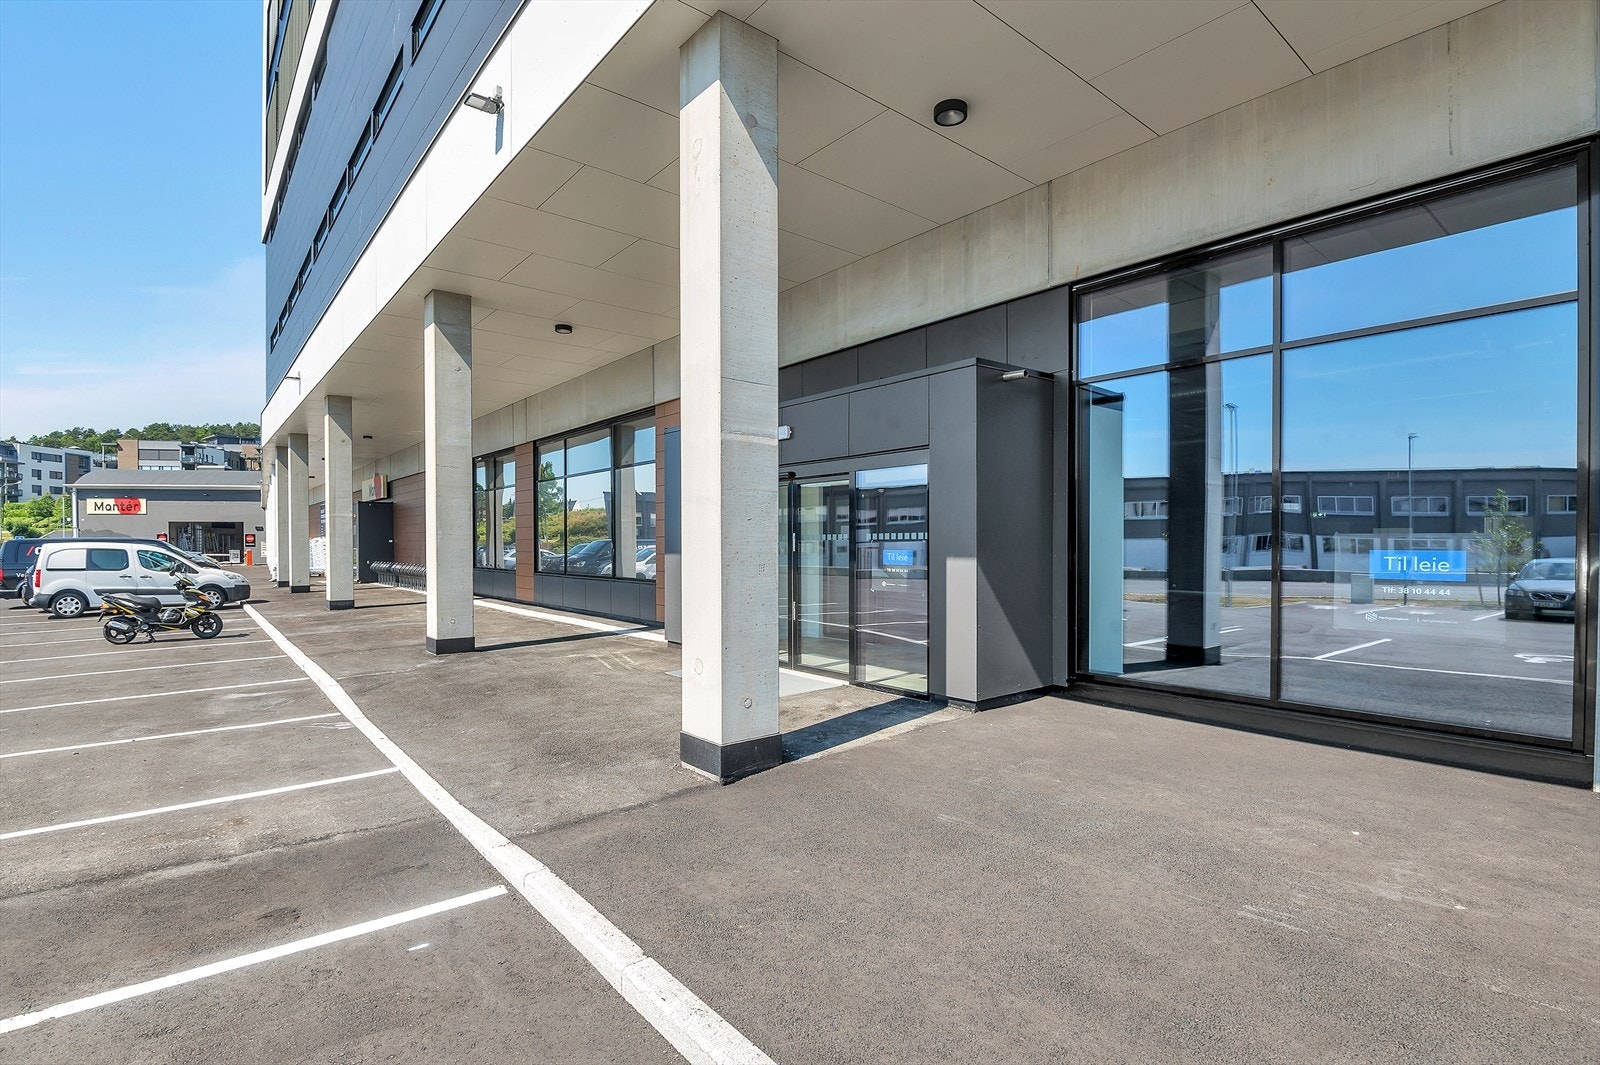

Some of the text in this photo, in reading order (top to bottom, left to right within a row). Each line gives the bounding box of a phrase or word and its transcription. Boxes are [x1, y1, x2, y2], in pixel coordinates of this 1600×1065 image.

[94, 501, 139, 511] Montér
[1384, 556, 1450, 572] Til leie
[1382, 586, 1396, 594] Tlf:
[1411, 587, 1422, 595] 10
[1438, 588, 1451, 596] 44
